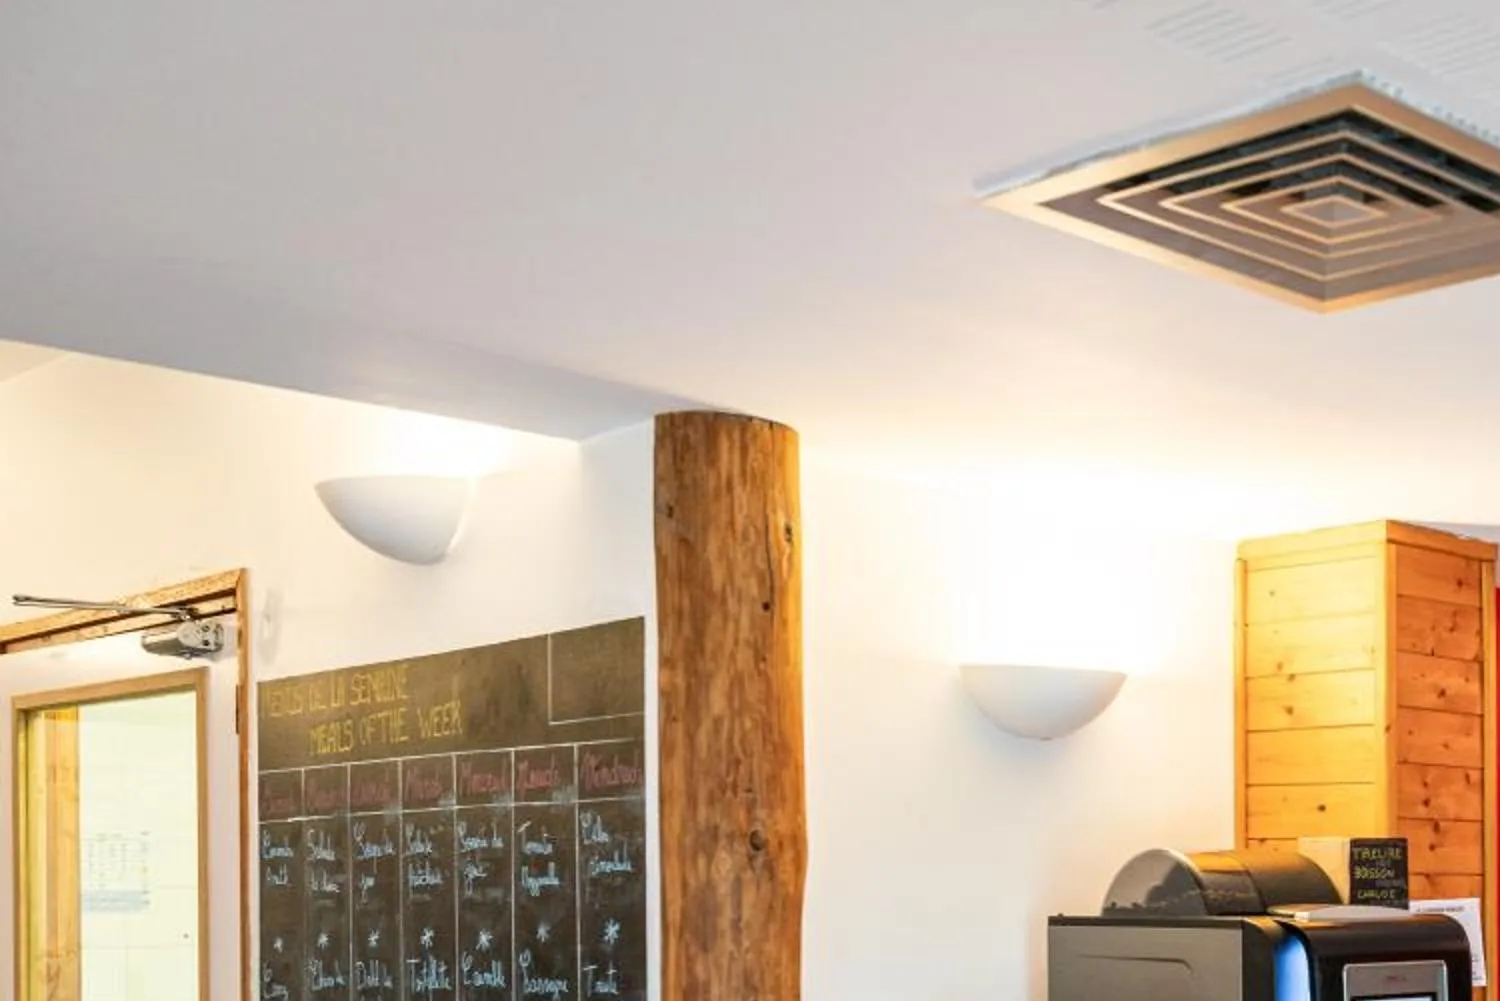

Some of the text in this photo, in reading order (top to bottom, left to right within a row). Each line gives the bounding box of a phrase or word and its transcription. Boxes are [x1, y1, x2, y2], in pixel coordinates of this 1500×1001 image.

[309, 717, 355, 757] MEALS
[374, 706, 410, 745] THE
[416, 699, 464, 740] WEEK
